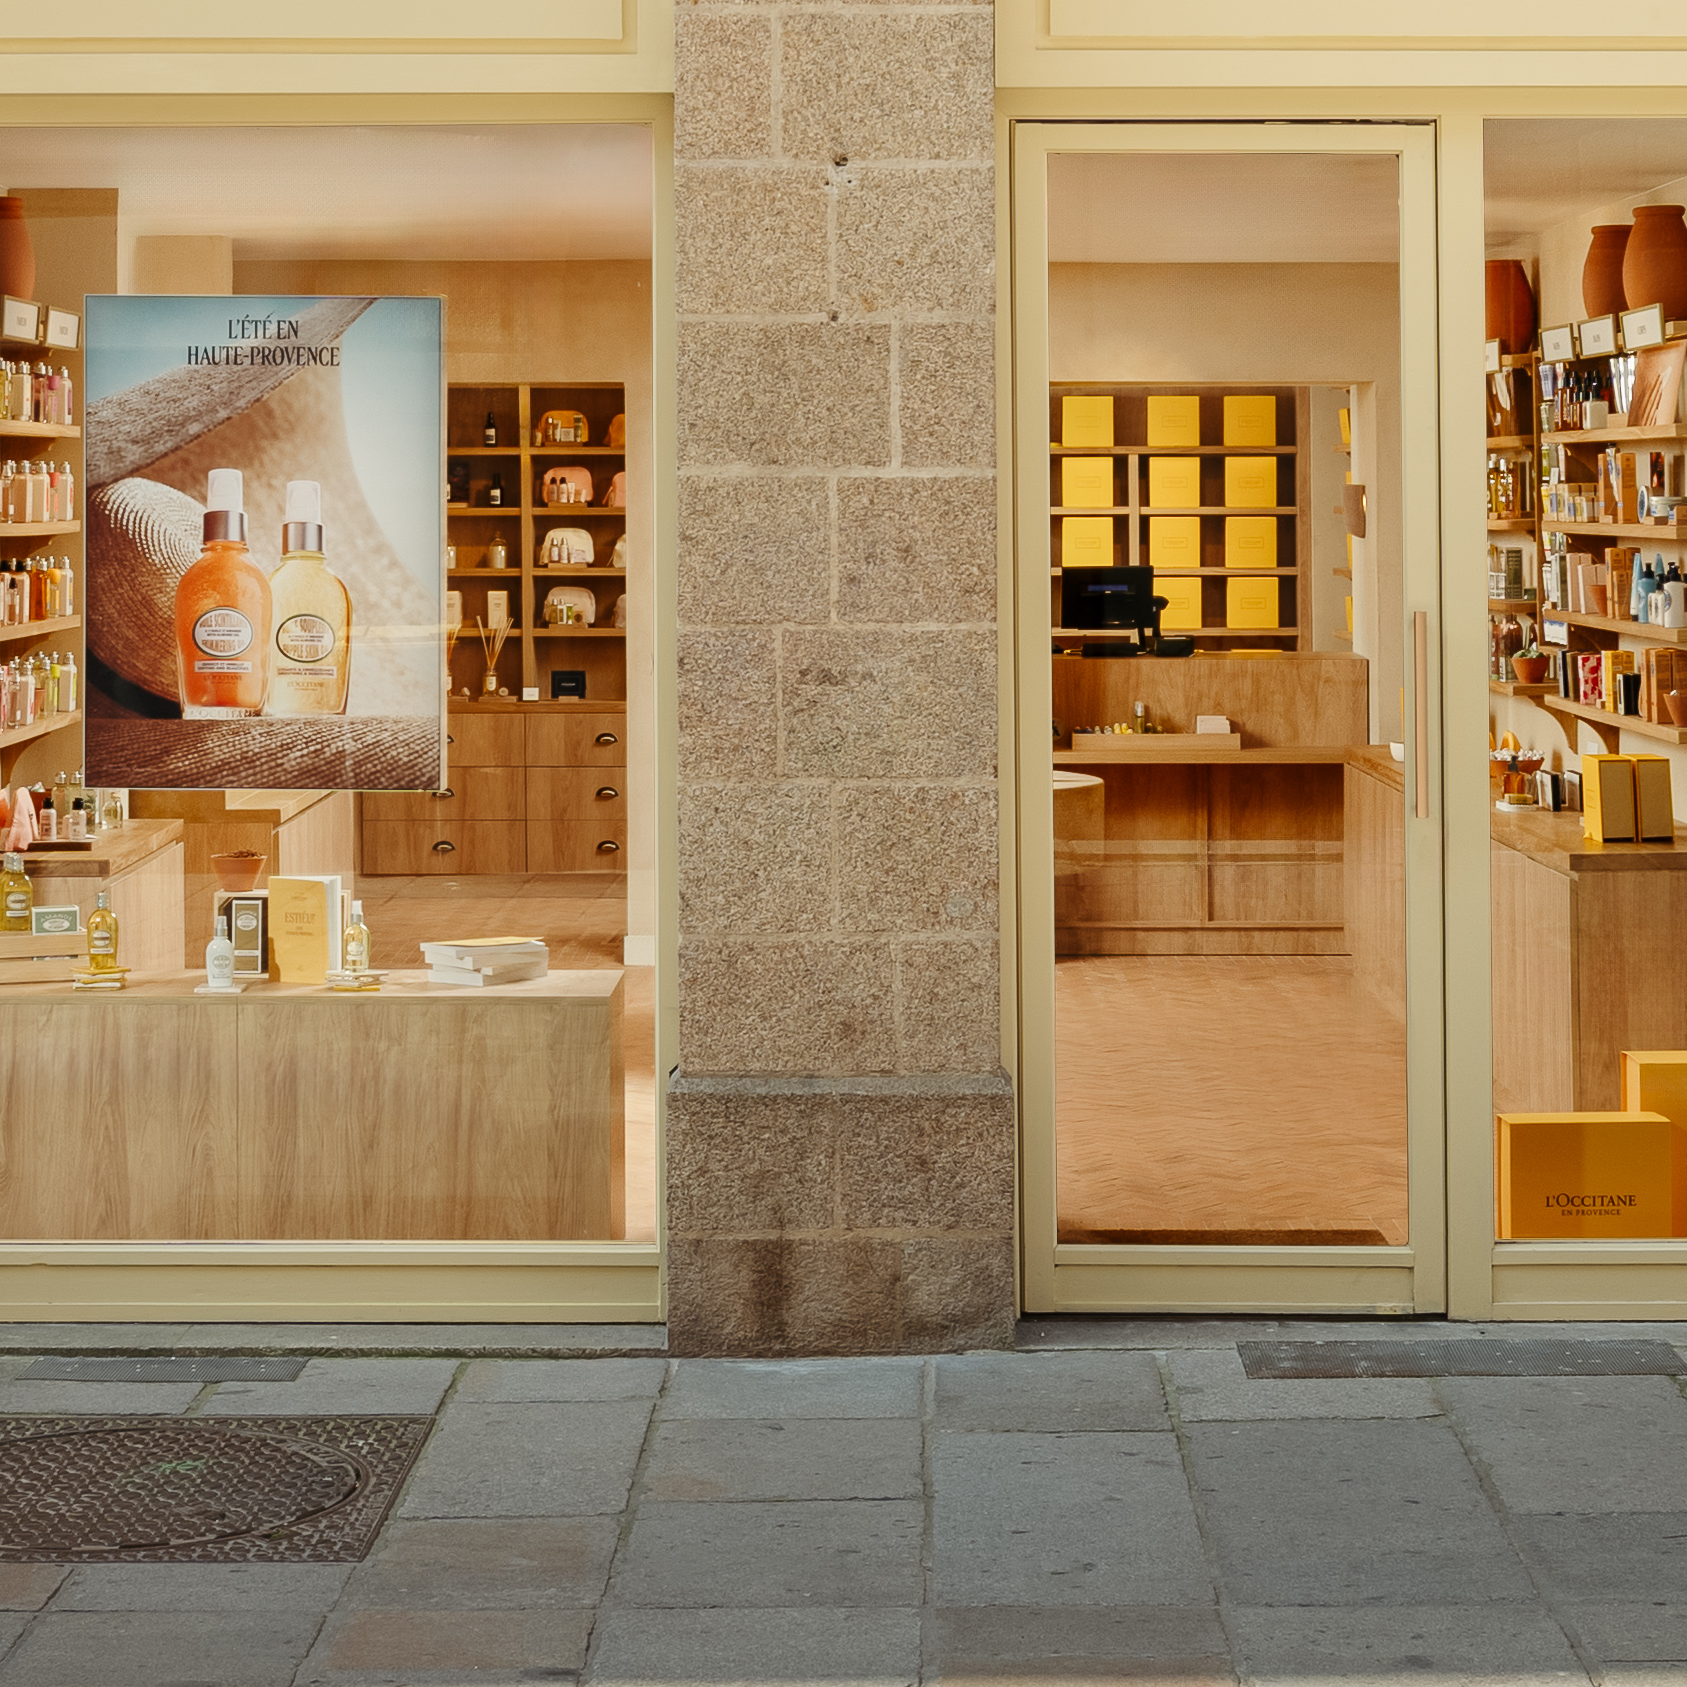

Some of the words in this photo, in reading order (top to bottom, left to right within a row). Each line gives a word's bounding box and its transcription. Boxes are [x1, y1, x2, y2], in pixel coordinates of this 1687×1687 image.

[277, 319, 299, 340] EN
[187, 345, 340, 367] HAUTE-PROVENCE
[1545, 1192, 1637, 1208] L'OCCITANE
[1574, 1208, 1622, 1216] PROVENCE
